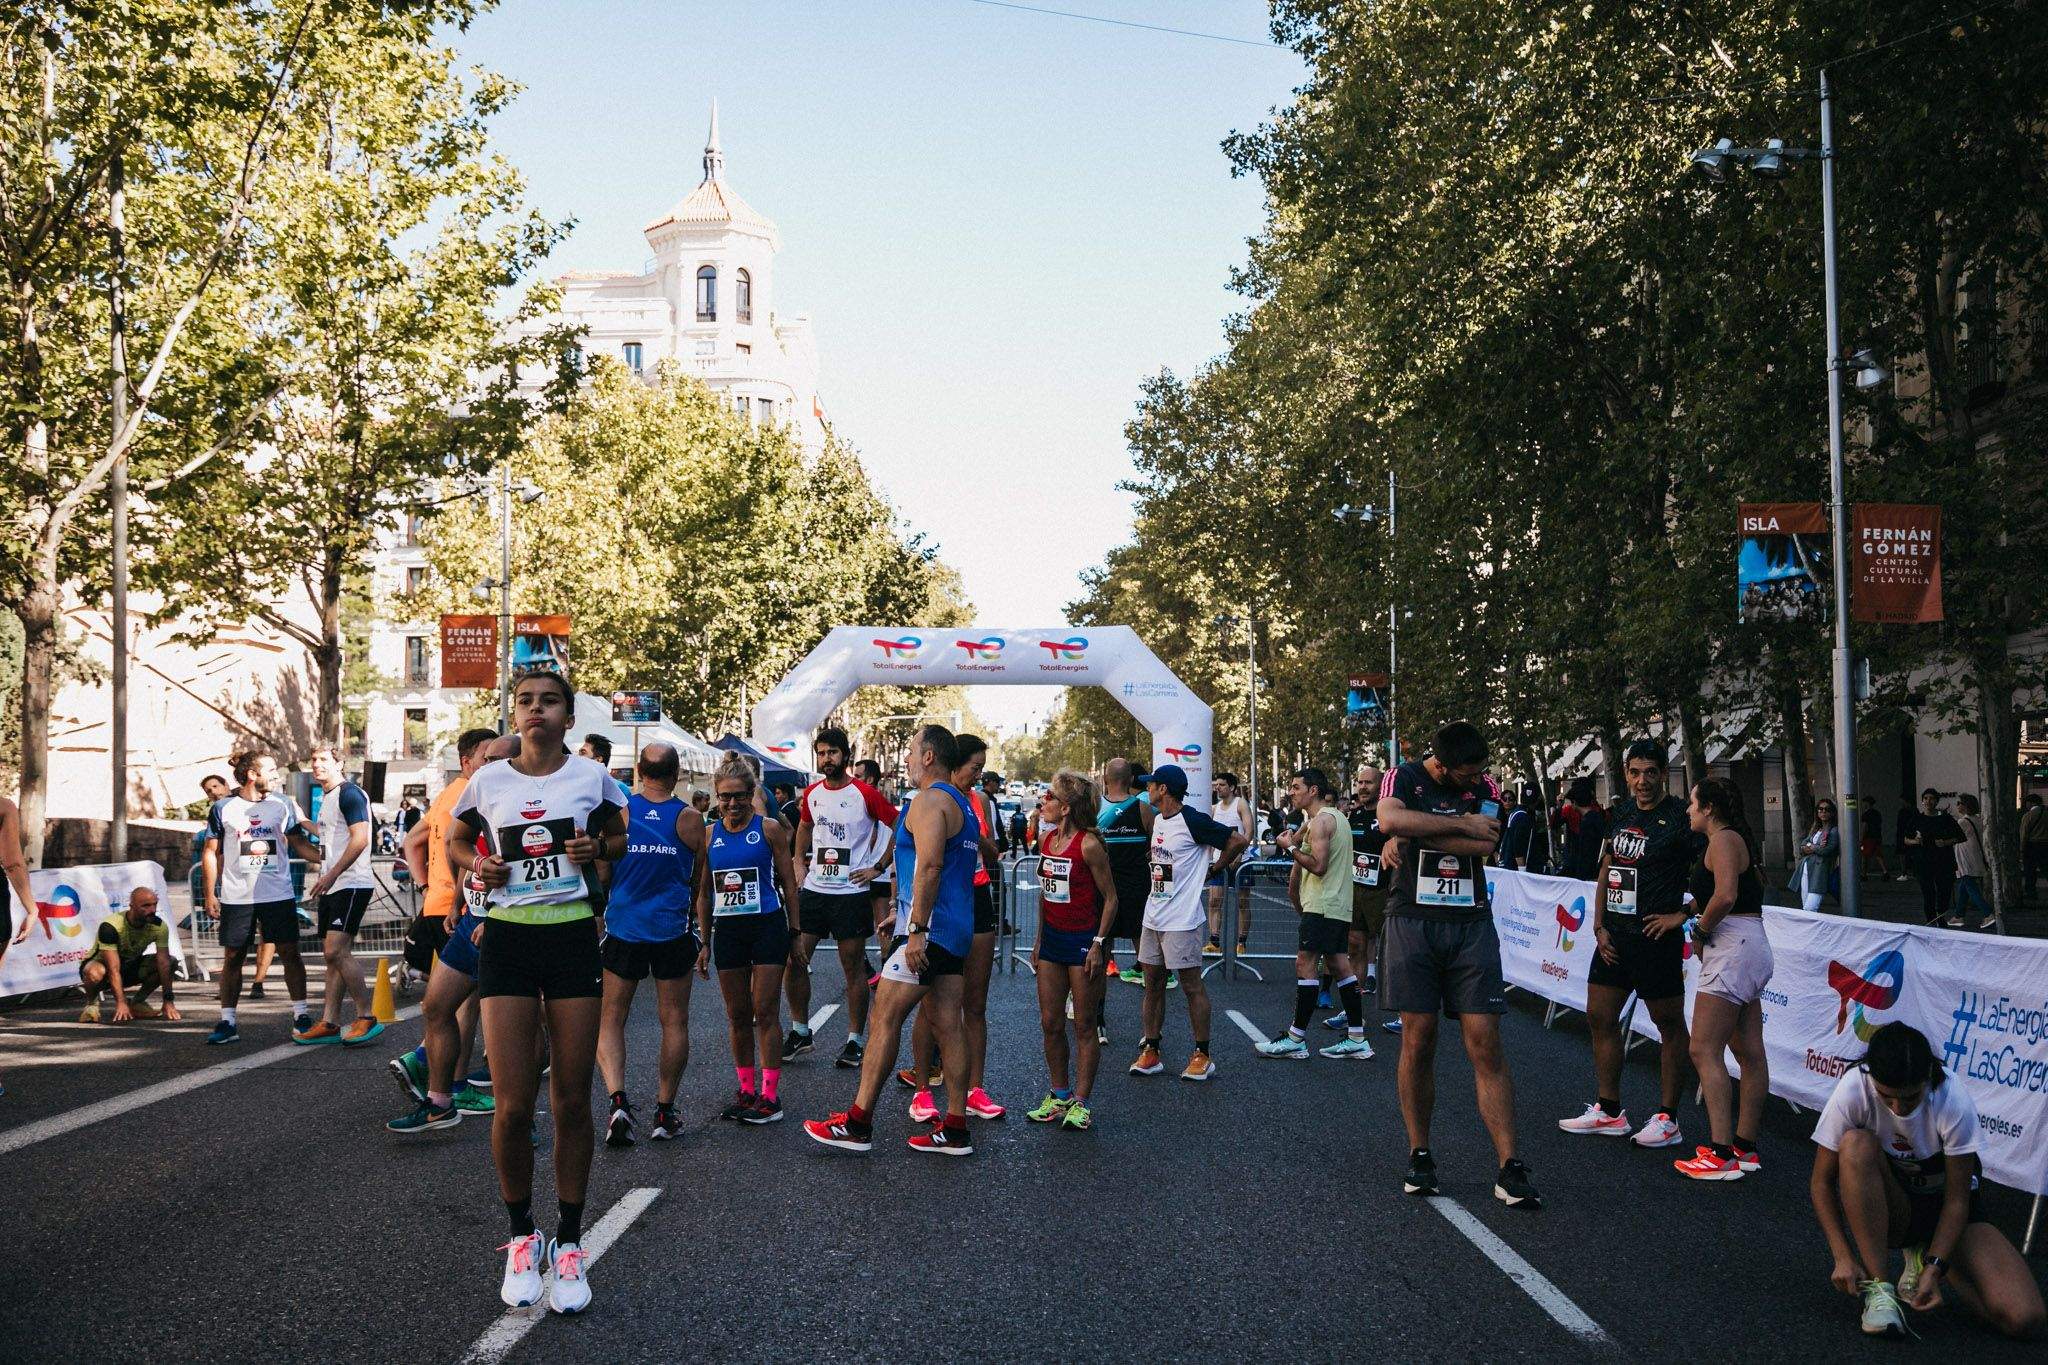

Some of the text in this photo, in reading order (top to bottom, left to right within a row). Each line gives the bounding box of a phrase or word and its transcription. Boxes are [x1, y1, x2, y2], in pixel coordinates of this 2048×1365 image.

[1743, 517, 1780, 531] ISLA
[1863, 526, 1931, 541] FERNÁN
[1862, 540, 1931, 556] GÓMEZ
[1900, 577, 1930, 585] VILLA
[447, 626, 492, 636] FERNÁN
[517, 622, 541, 632] ISLA
[447, 635, 492, 646] GÓMEZ
[873, 662, 922, 671] TotalEnergies
[955, 663, 1006, 672] TotalEnergies
[1039, 664, 1089, 672] TotalEnergies
[1350, 679, 1368, 687] ISLA
[522, 856, 560, 882] 231
[822, 865, 840, 876] 208
[1355, 867, 1370, 878] 203
[748, 883, 757, 900] 3188
[1436, 879, 1461, 895] 211
[723, 891, 747, 907] 226
[1760, 987, 1788, 1007] atrocina
